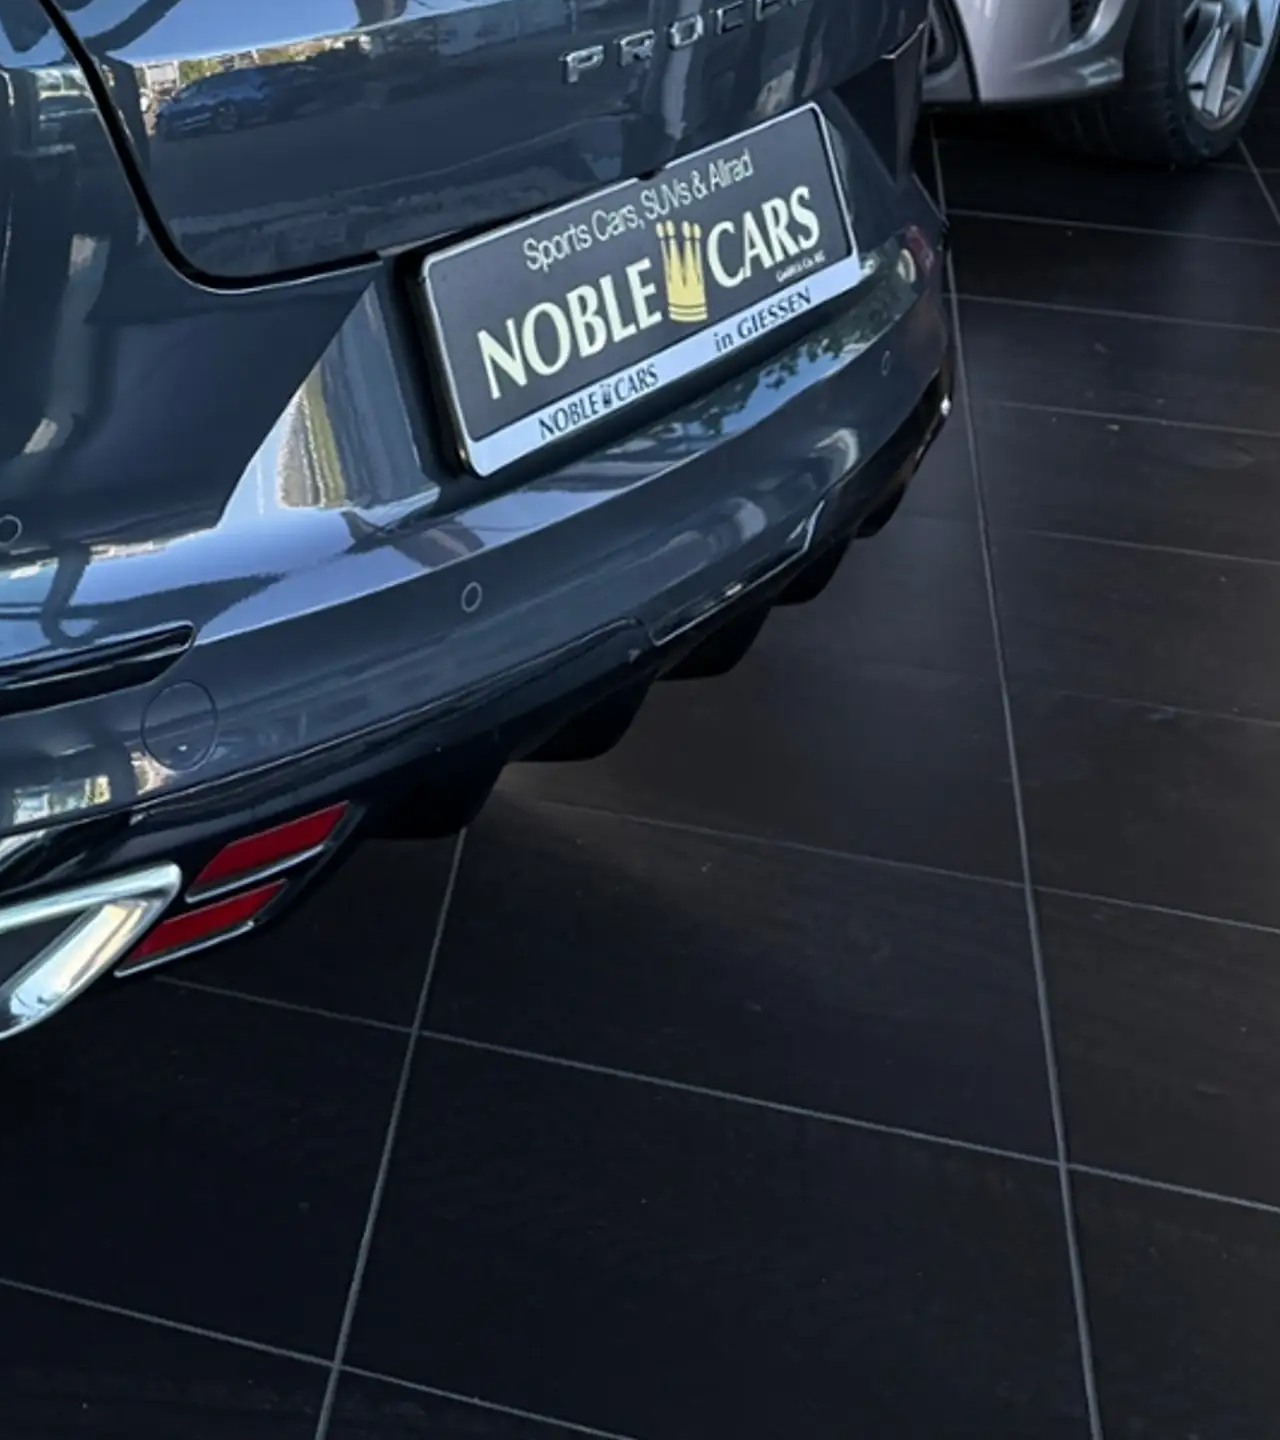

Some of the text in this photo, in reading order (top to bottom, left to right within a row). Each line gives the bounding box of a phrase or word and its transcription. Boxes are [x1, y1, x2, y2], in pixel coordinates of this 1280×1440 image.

[523, 149, 754, 273] Sports Cars, SUVs & Allrad
[476, 185, 821, 401] NOBLE CARS
[713, 286, 813, 354] in GIESSEN
[539, 363, 660, 441] NOBLE CARS
